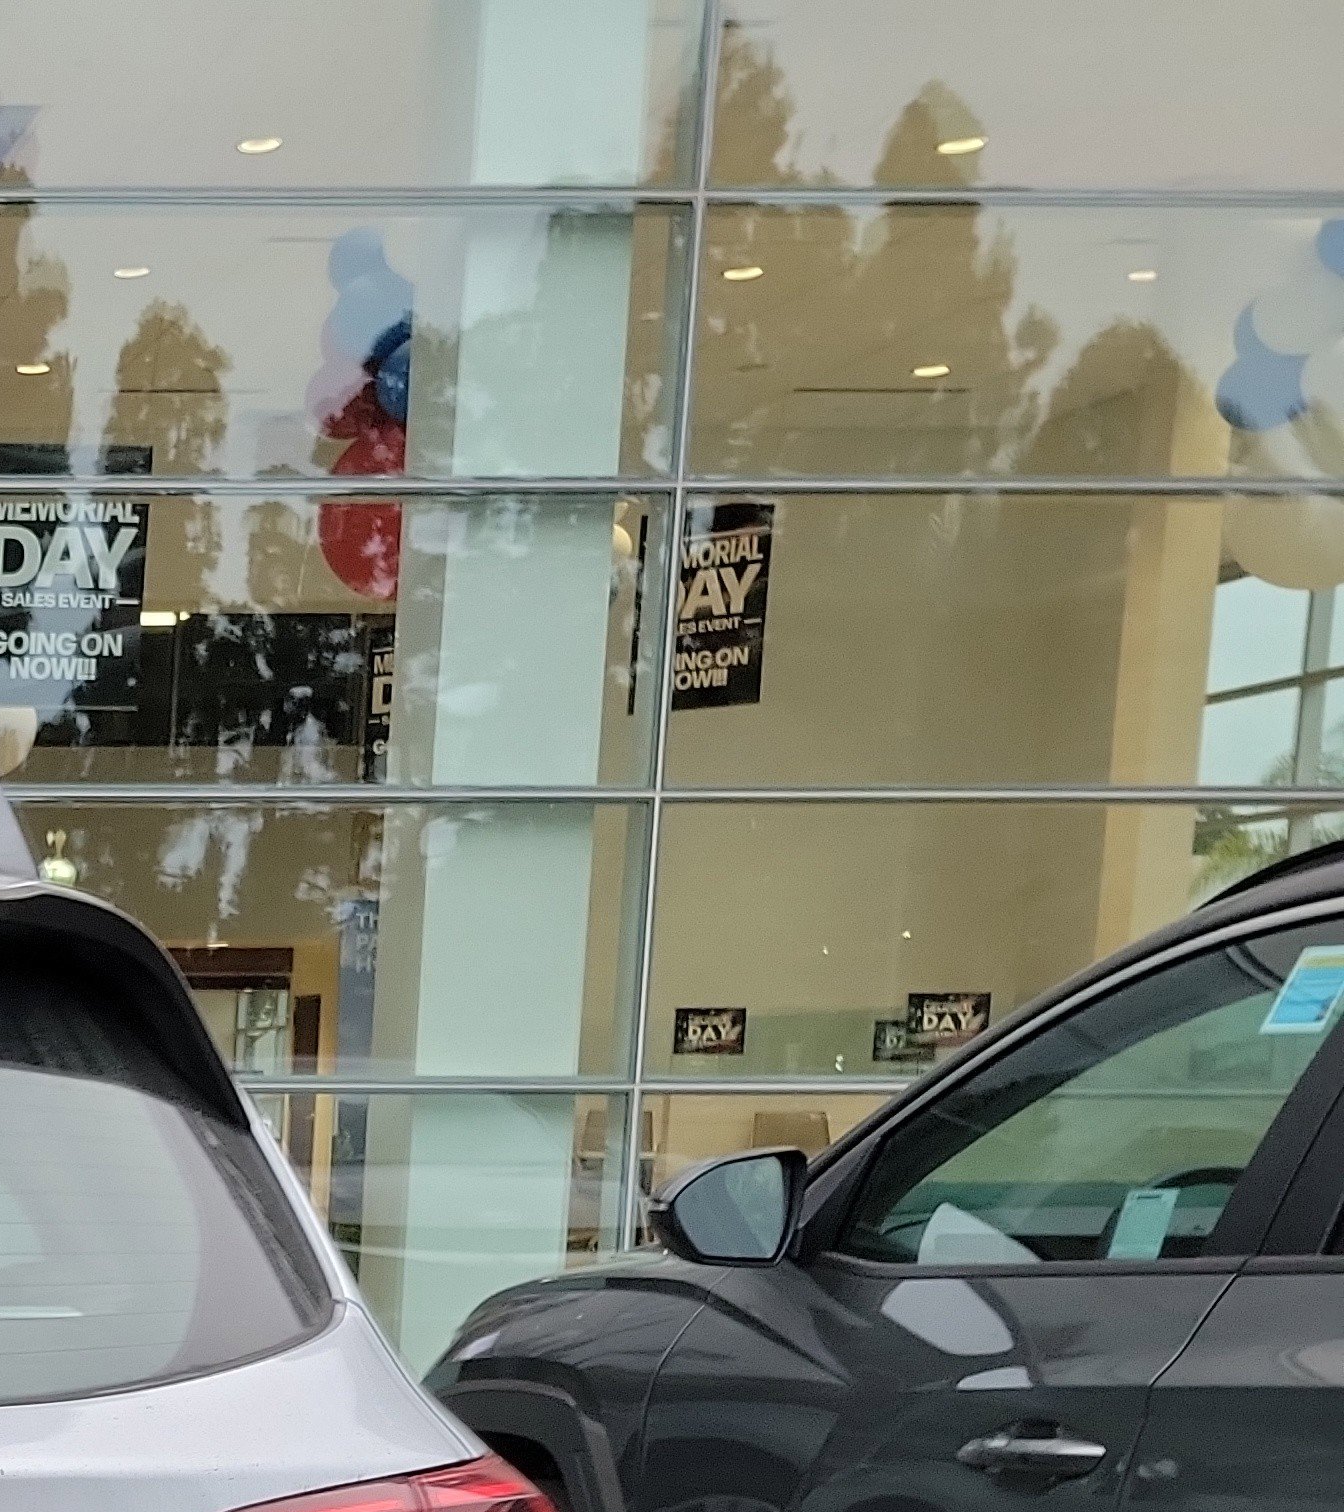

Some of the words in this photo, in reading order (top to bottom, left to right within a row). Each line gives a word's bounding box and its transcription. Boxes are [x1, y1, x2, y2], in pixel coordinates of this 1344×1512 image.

[682, 535, 763, 570] MORIAL
[1, 593, 56, 608] SALES
[61, 594, 113, 609] EVENT
[81, 633, 124, 657] ON
[675, 650, 714, 672] ING
[715, 646, 750, 669] ON
[675, 667, 729, 691] OW!!!
